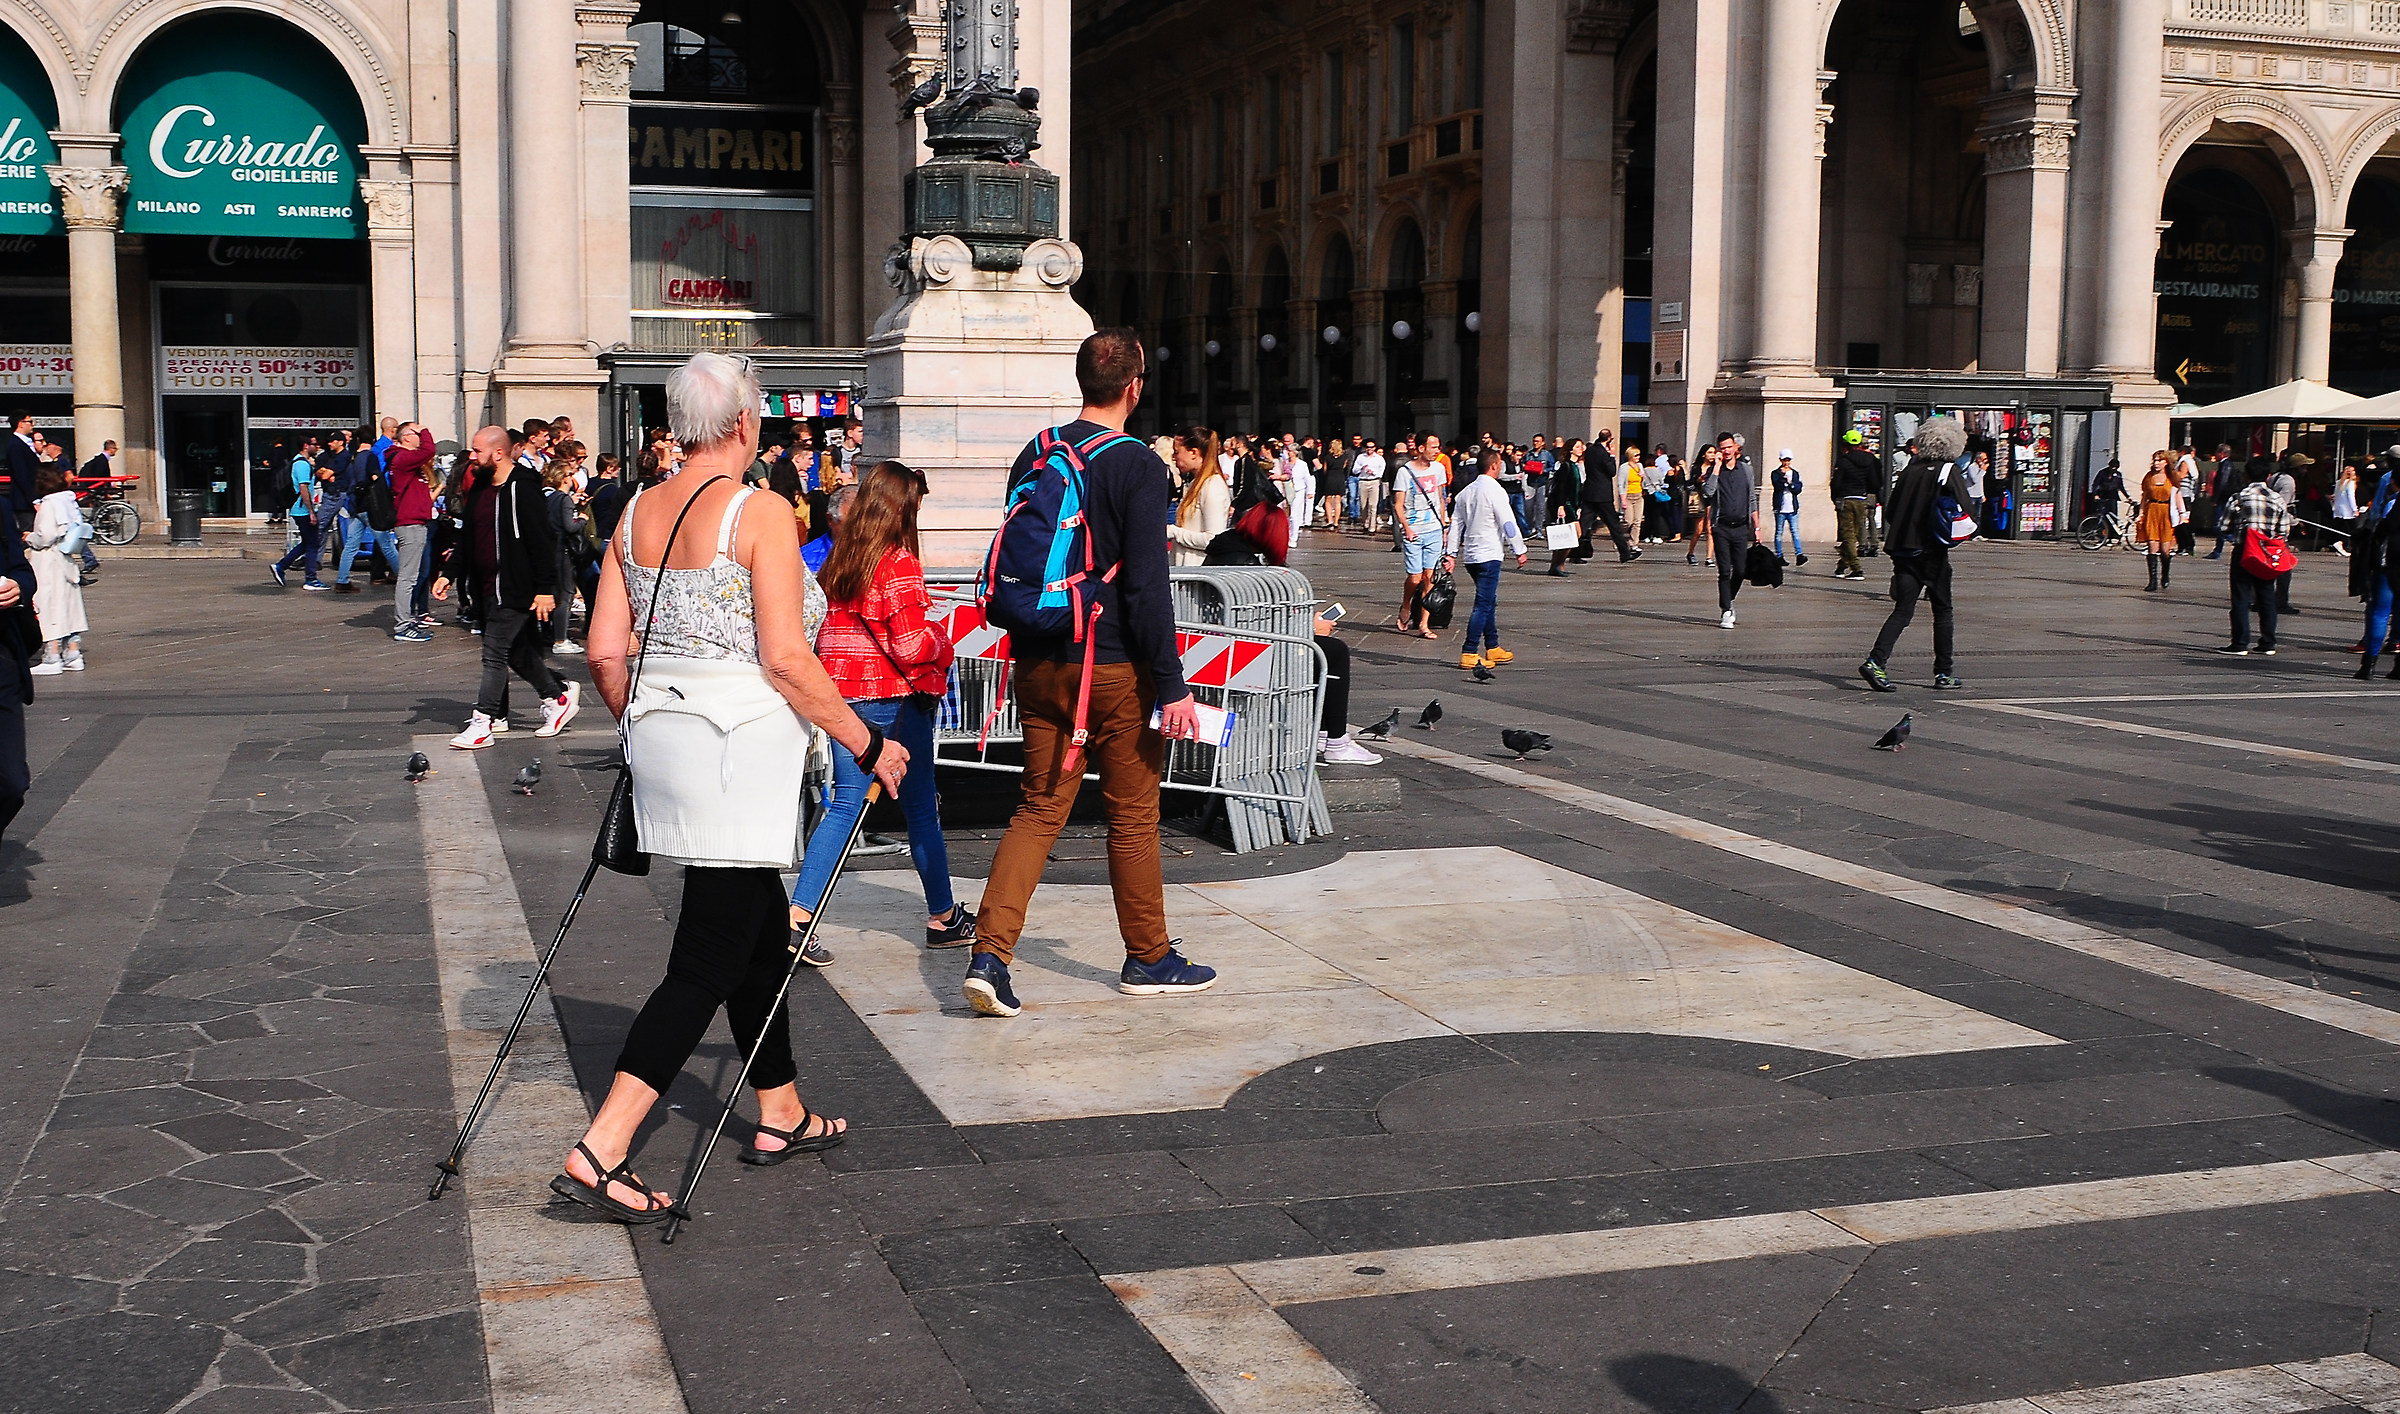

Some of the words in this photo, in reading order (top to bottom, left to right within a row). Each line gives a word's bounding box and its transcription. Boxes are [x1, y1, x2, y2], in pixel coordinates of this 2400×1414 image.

[148, 104, 340, 179] Currado
[231, 168, 339, 184] GIOIELLERIE
[137, 200, 201, 214] MILANO
[223, 203, 256, 216] ASTI
[277, 205, 354, 219] SANREMO
[2176, 241, 2266, 263] MERCATO
[2197, 262, 2241, 274] DUOMO
[668, 278, 753, 299] CAMPARI
[2154, 280, 2260, 299] RESTAURANTS
[167, 348, 229, 358] VENDITA
[234, 348, 354, 359] PROMOZIONALE
[167, 366, 252, 374] SCONTO
[0, 374, 74, 386] TUTT
